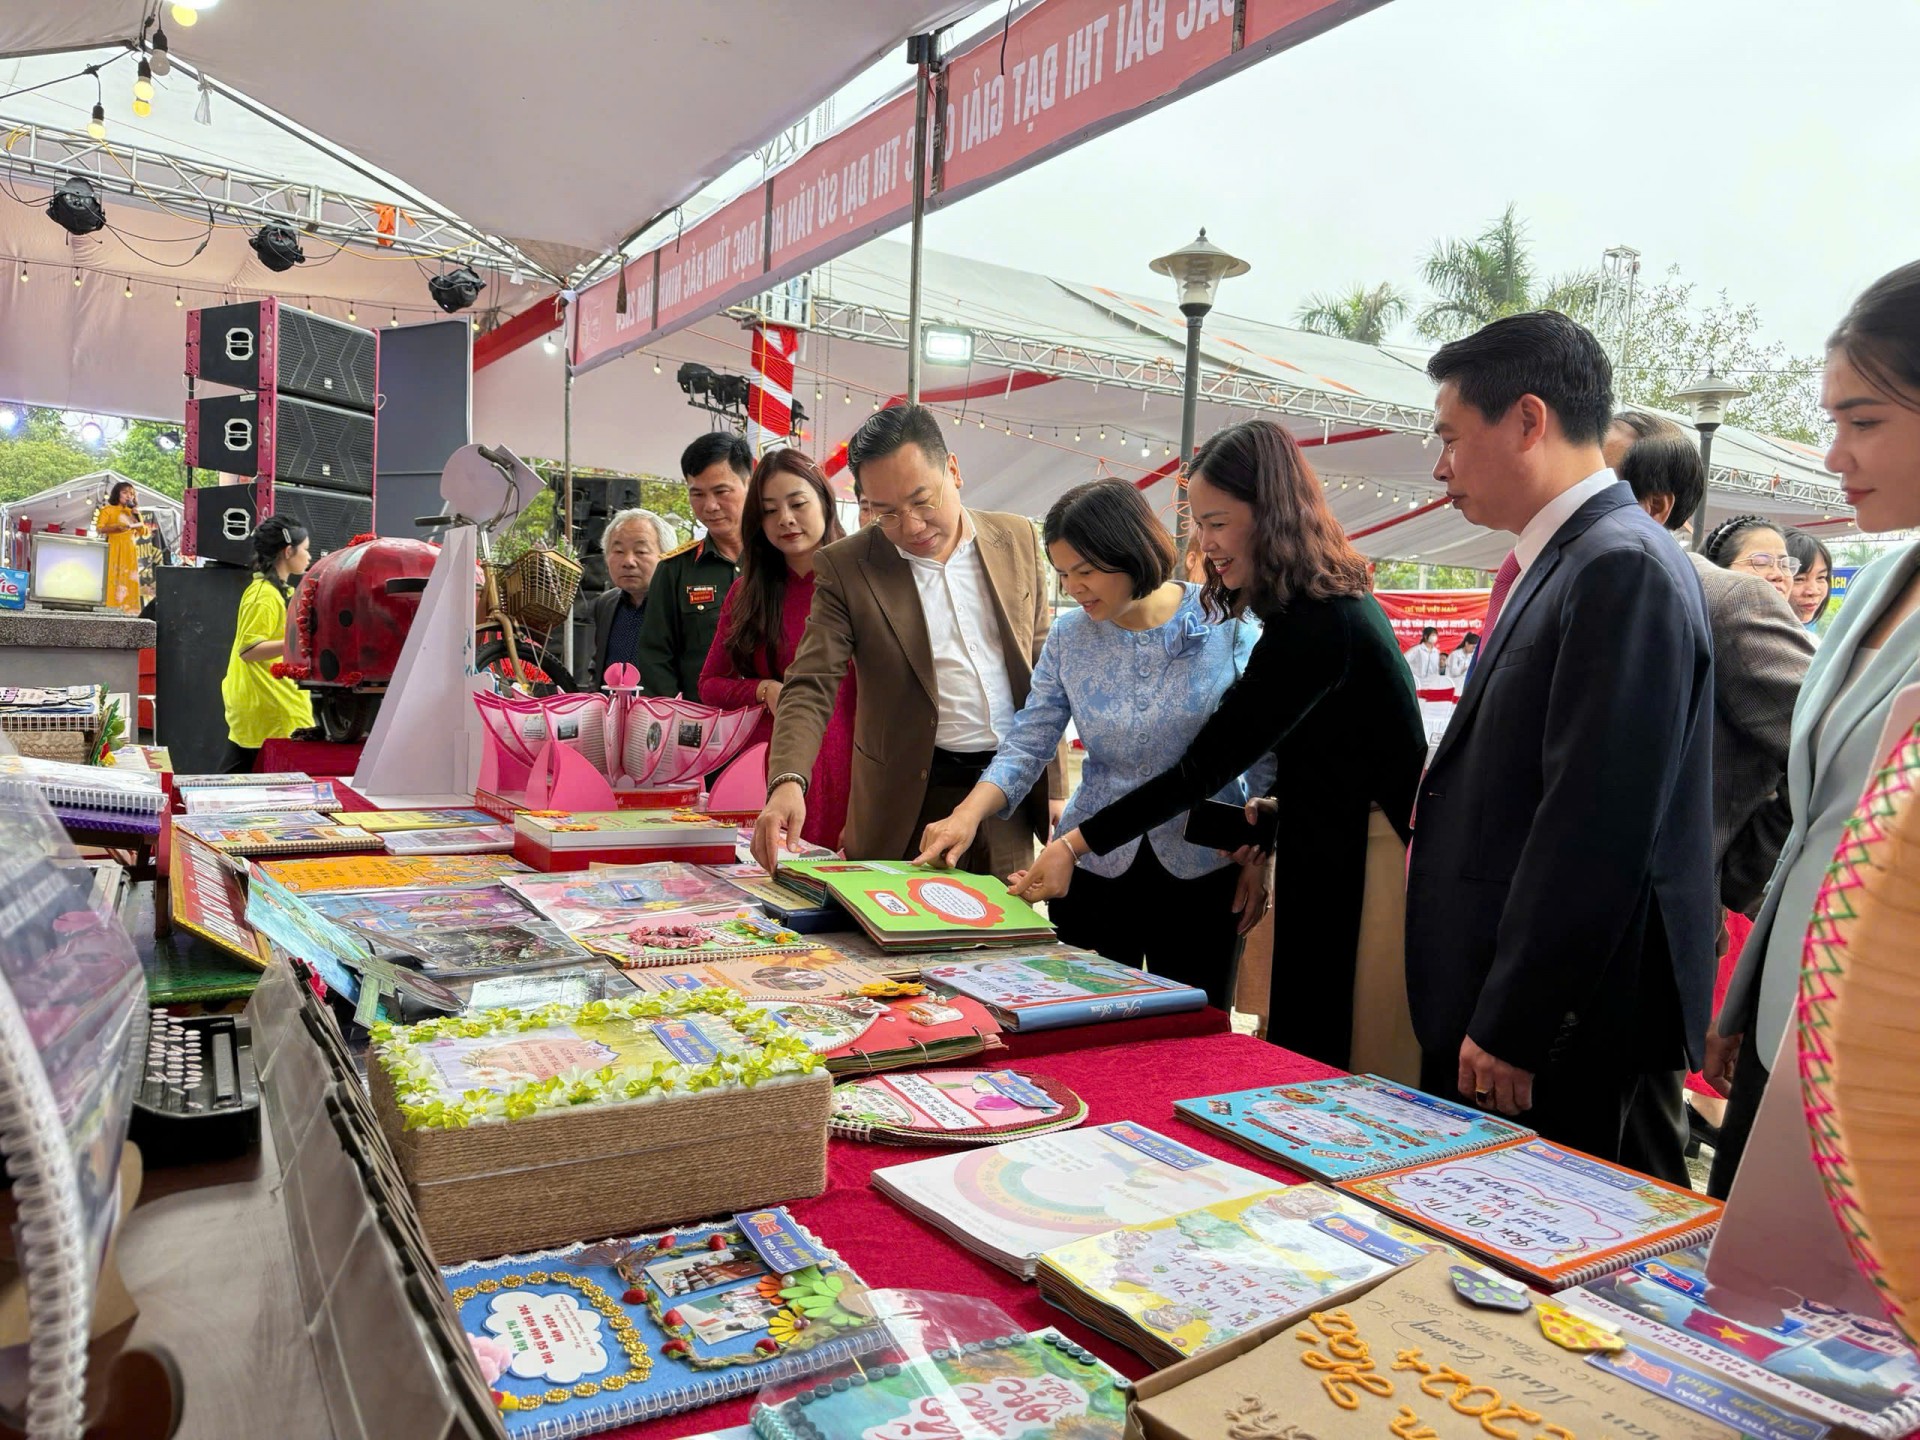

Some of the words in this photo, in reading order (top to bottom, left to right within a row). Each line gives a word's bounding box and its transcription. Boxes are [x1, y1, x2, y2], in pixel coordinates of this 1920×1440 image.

[202, 910, 249, 944] ĐẠI
[1422, 1195, 1453, 1213] Thi
[1493, 1226, 1536, 1248] Bài
[1577, 1291, 1625, 1314] 2024
[505, 1320, 518, 1331] THI
[1620, 1310, 1664, 1333] NĂM
[530, 1327, 543, 1341] VĂN
[1650, 1333, 1683, 1350] THI
[540, 1351, 555, 1365] ĐẠI
[1038, 1377, 1083, 1406] 2024
[1486, 1364, 1590, 1407] Minh
[1560, 1366, 1617, 1395] THCS
[1750, 1368, 1793, 1392] VĂN
[991, 1378, 1063, 1423] Đọc
[1390, 1346, 1542, 1440] 2024
[1739, 1416, 1766, 1433] THI
